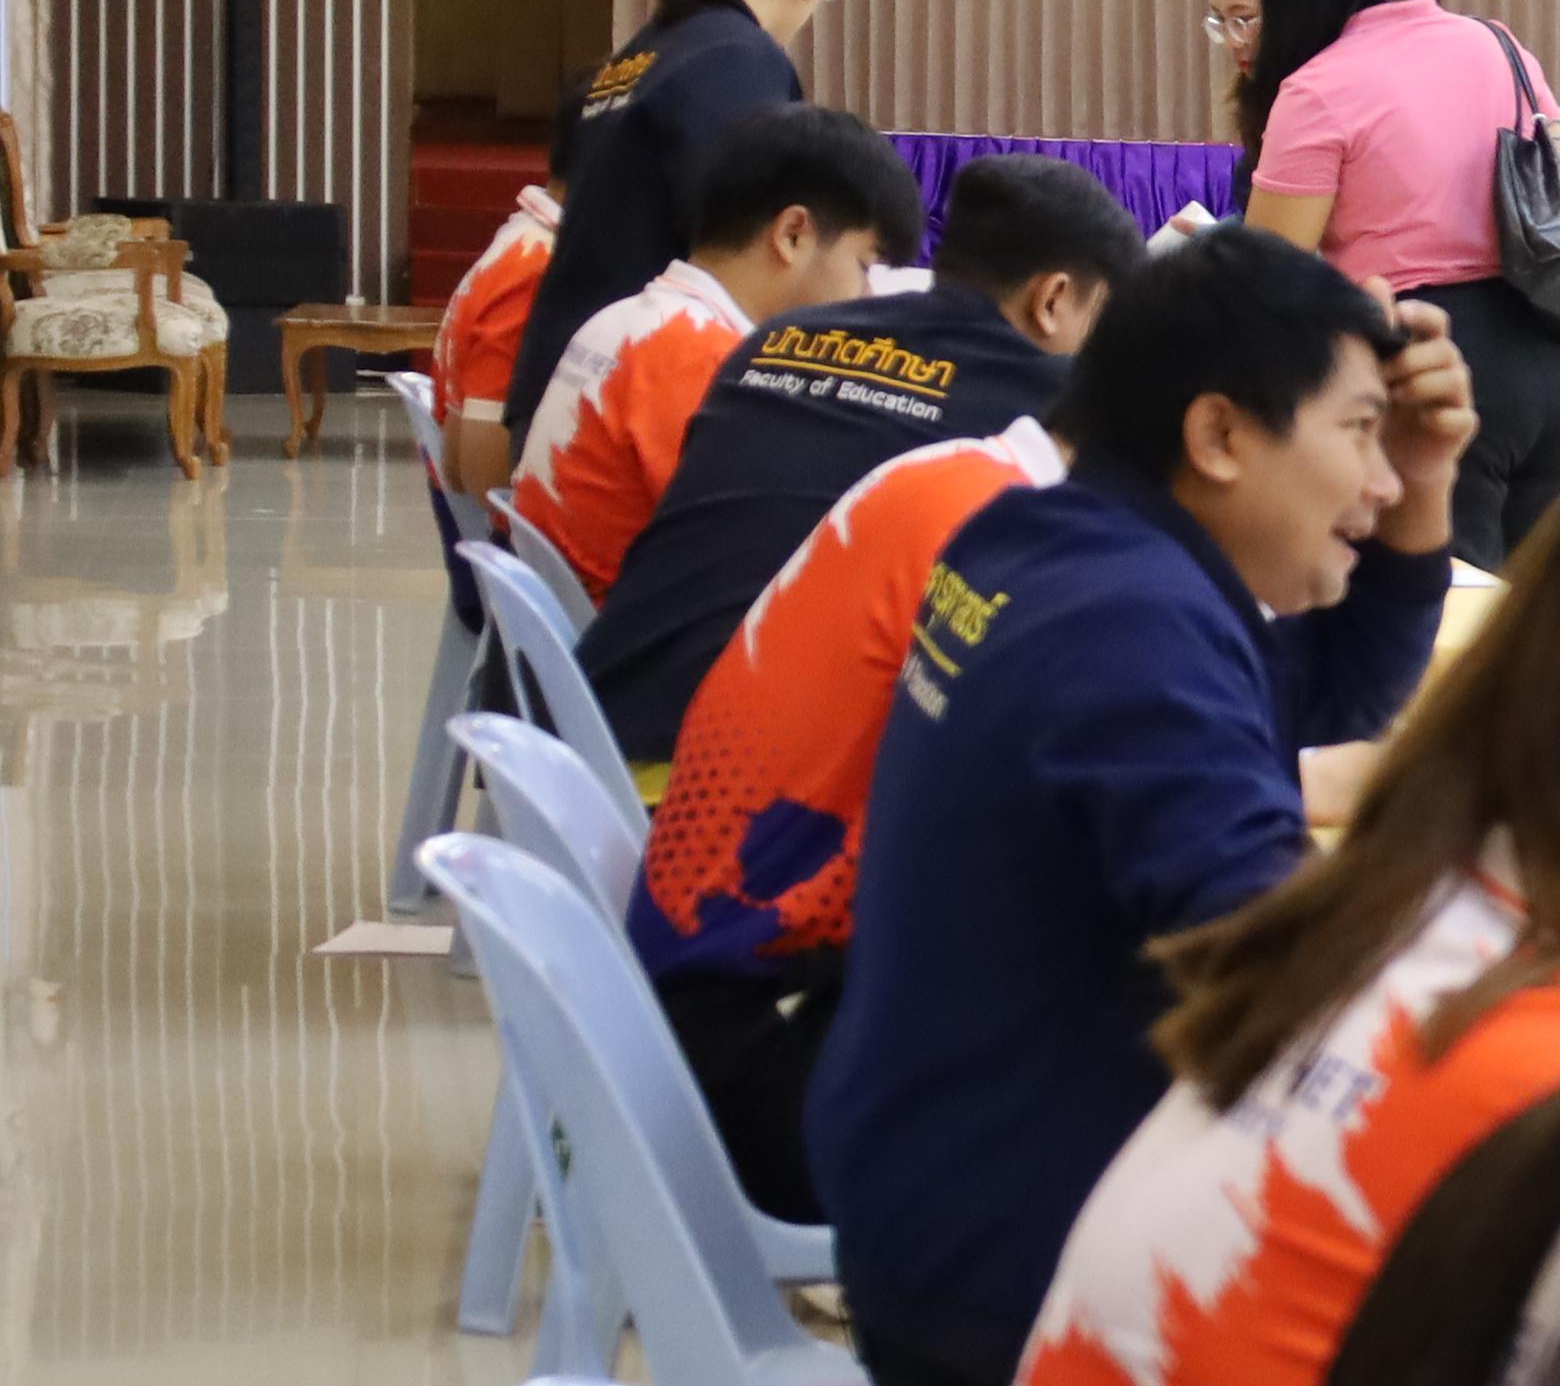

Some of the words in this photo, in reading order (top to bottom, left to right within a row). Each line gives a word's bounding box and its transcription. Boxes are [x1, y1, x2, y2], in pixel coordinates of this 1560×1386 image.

[761, 326, 957, 387] บัณฑิตศึกษา
[740, 369, 804, 396] Faculty
[809, 376, 834, 396] of
[836, 381, 943, 421] Education
